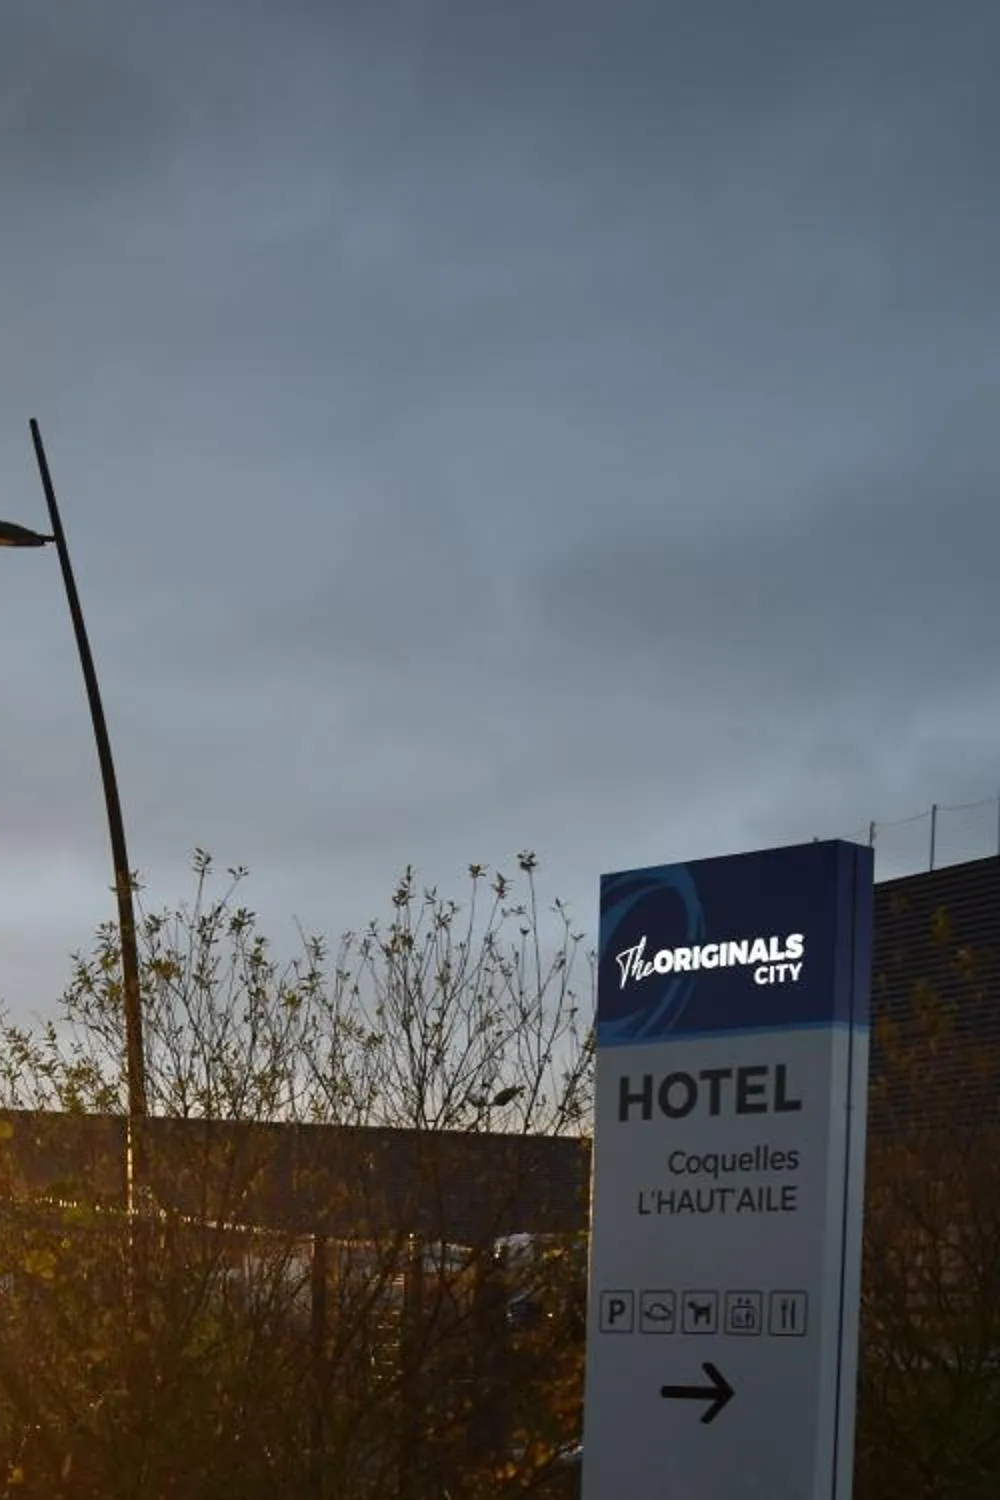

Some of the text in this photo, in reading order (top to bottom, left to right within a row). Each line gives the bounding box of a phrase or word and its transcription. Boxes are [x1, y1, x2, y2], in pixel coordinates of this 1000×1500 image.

[653, 933, 805, 974] ORIGINALS
[754, 961, 803, 985] CITY
[618, 1064, 802, 1122] HOTEL
[668, 1144, 800, 1179] Coquelles
[608, 1299, 626, 1325] P
